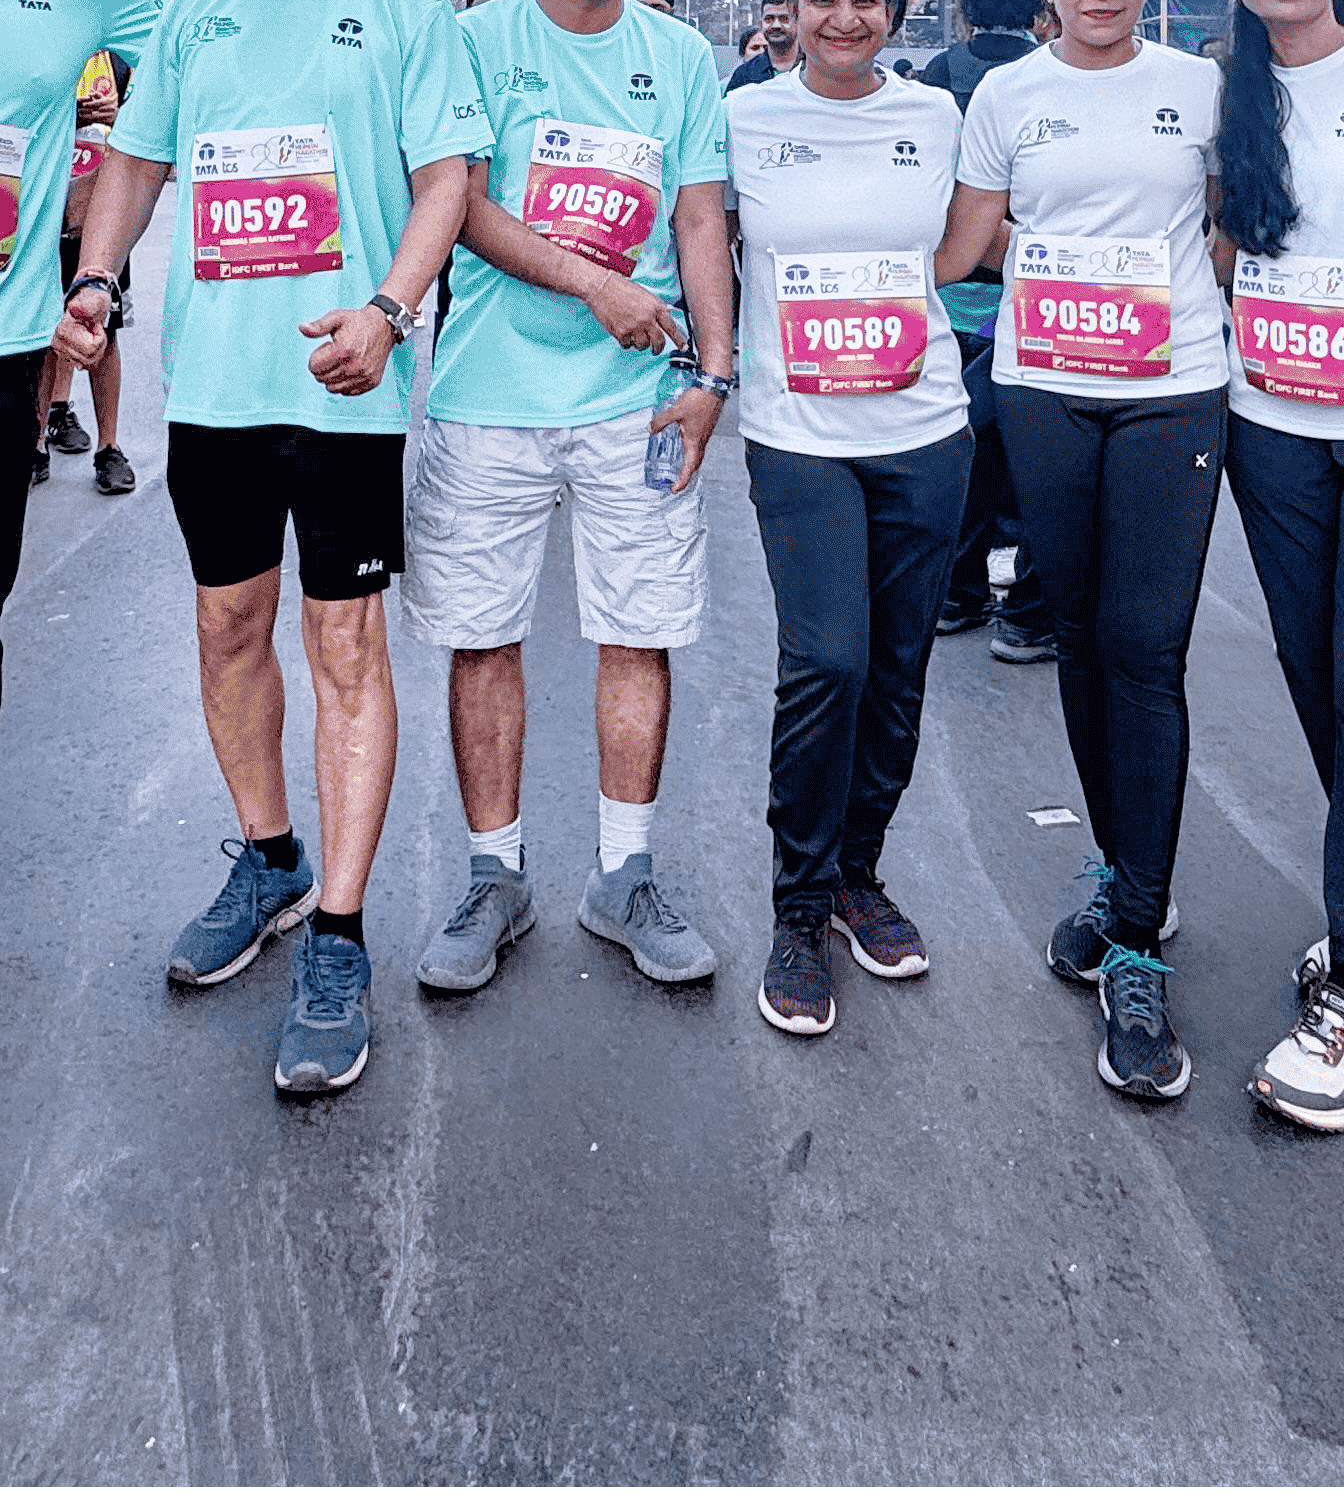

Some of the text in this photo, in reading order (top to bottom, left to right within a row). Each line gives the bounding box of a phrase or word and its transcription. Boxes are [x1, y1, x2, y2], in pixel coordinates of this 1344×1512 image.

[18, 0, 52, 11] TATA
[331, 34, 362, 50] TATA
[628, 90, 657, 101] TATA
[453, 103, 477, 119] tcs
[1152, 125, 1183, 136] TATA
[538, 148, 595, 162] TATA tcs
[892, 157, 921, 167] TATA
[195, 161, 239, 176] TATA tcs
[547, 183, 640, 227] 90587
[210, 194, 309, 234] 90592
[1020, 263, 1076, 275] TATA tcs
[782, 282, 839, 295] TATA tcs
[1238, 279, 1285, 295] TATA tcs
[1039, 298, 1142, 335] 90584
[804, 316, 902, 351] 90589
[1293, 386, 1316, 397] FIRST
